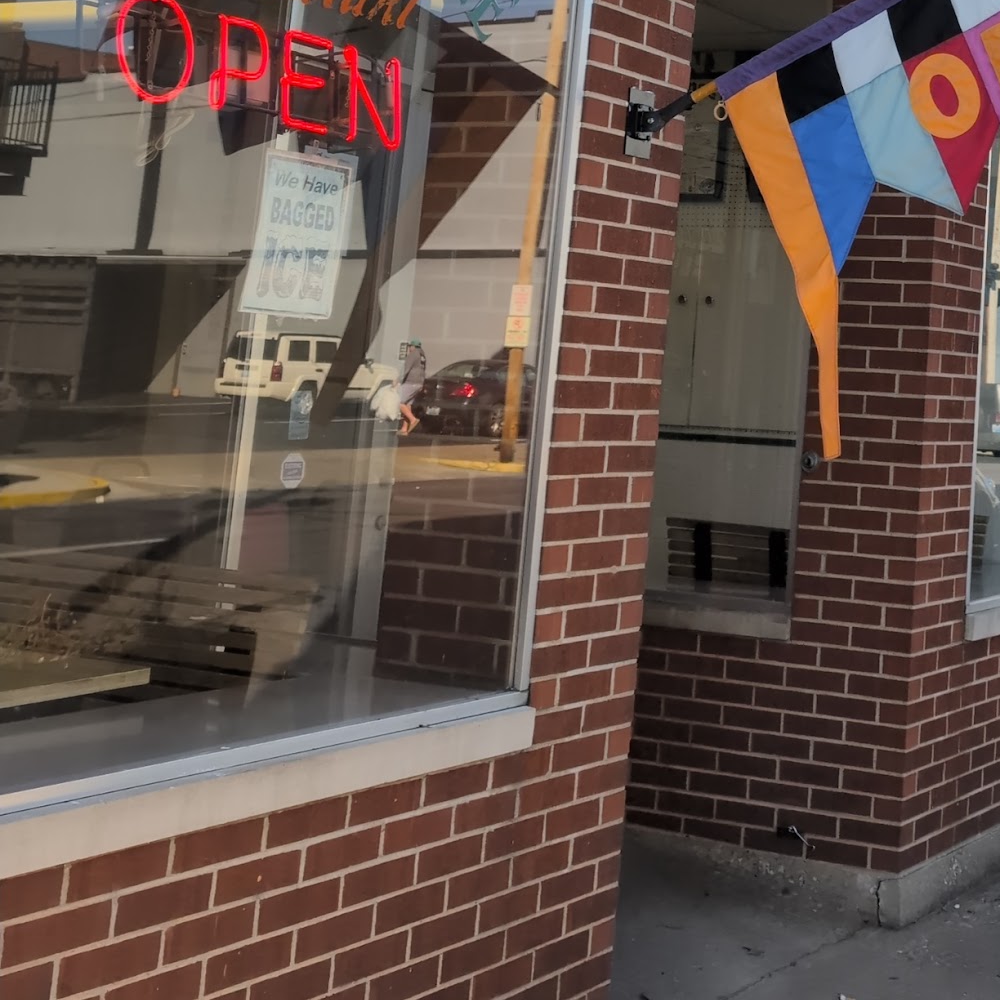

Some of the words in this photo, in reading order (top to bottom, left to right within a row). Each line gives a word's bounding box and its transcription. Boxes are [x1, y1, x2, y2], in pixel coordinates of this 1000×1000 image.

[274, 169, 299, 189] We
[302, 175, 339, 196] Have
[270, 196, 335, 231] BAGGED
[256, 232, 330, 301] ICE
